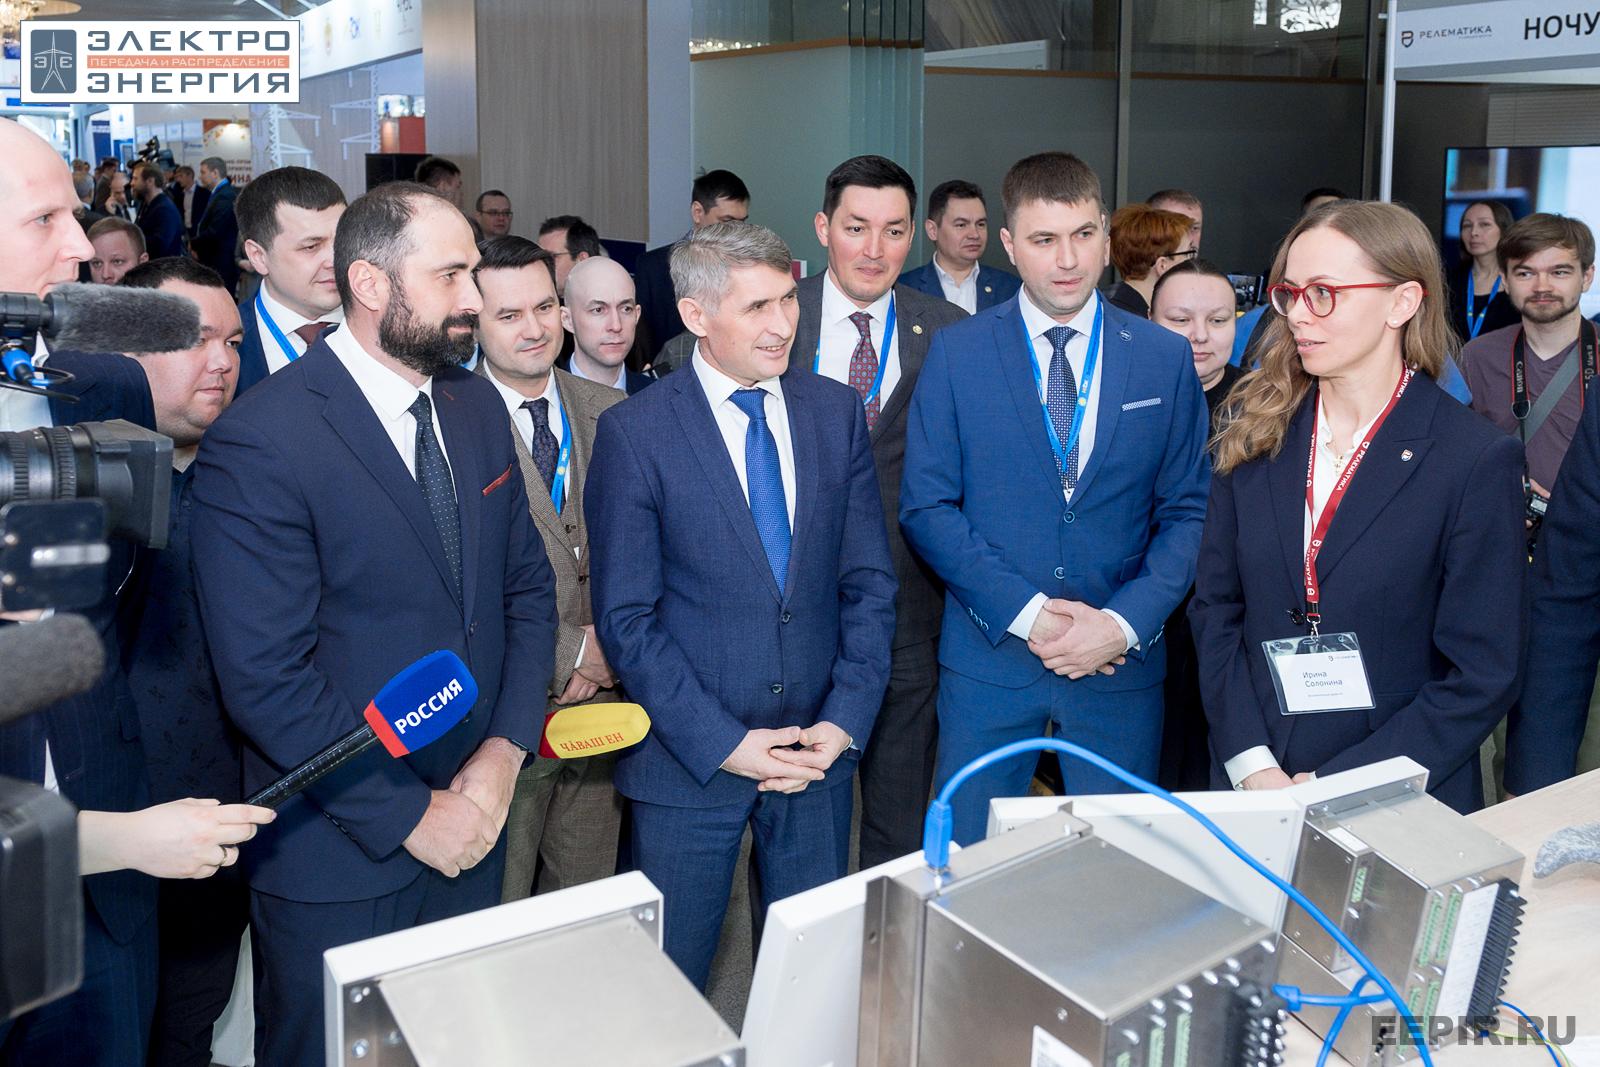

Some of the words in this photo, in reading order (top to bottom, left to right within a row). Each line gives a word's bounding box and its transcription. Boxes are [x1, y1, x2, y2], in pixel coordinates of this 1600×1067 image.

[1419, 25, 1492, 38] РЕЛЕМАТИКА
[1516, 361, 1524, 393] Canon
[1336, 449, 1366, 491] РЕЛЕМАТИКА
[394, 678, 464, 735] РОССИЯ
[605, 732, 625, 745] ЕН
